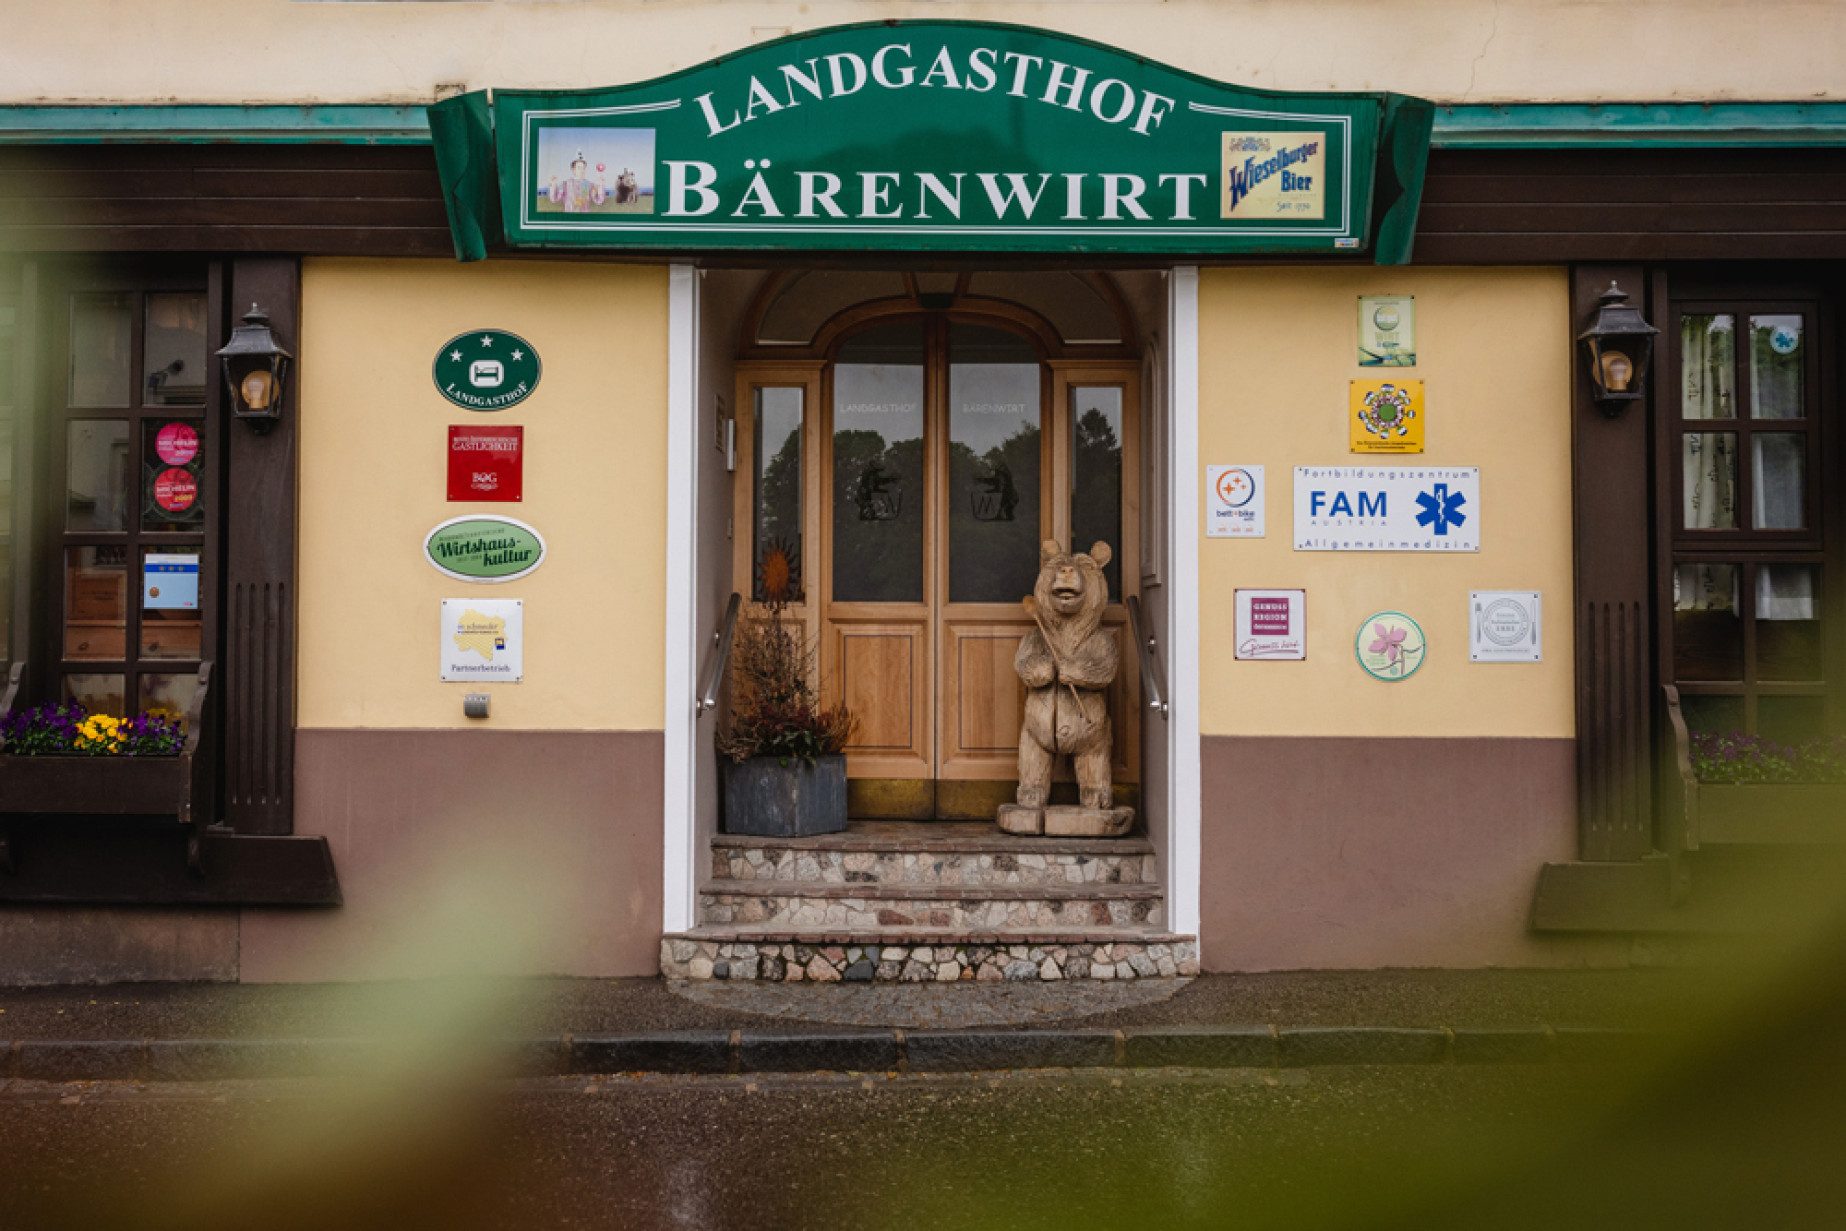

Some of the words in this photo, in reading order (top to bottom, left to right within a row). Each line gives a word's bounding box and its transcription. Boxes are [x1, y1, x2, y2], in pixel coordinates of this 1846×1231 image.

[694, 43, 1175, 138] LANDGASTHOF
[1229, 141, 1319, 212] Wieselburger
[1281, 170, 1313, 192] Bier
[661, 158, 1207, 220] BÄRENWIRT
[446, 381, 527, 406] LANDGASTHOF
[1304, 468, 1470, 480] Fortbildungszentrum
[1310, 490, 1388, 518] FAM
[1311, 519, 1387, 527] AUSTRIA
[437, 537, 521, 558] Wirtshaus-
[1304, 538, 1470, 550] Allgemeinmedizin
[483, 549, 532, 567] kultur
[451, 664, 511, 673] Partnerbetrieb
